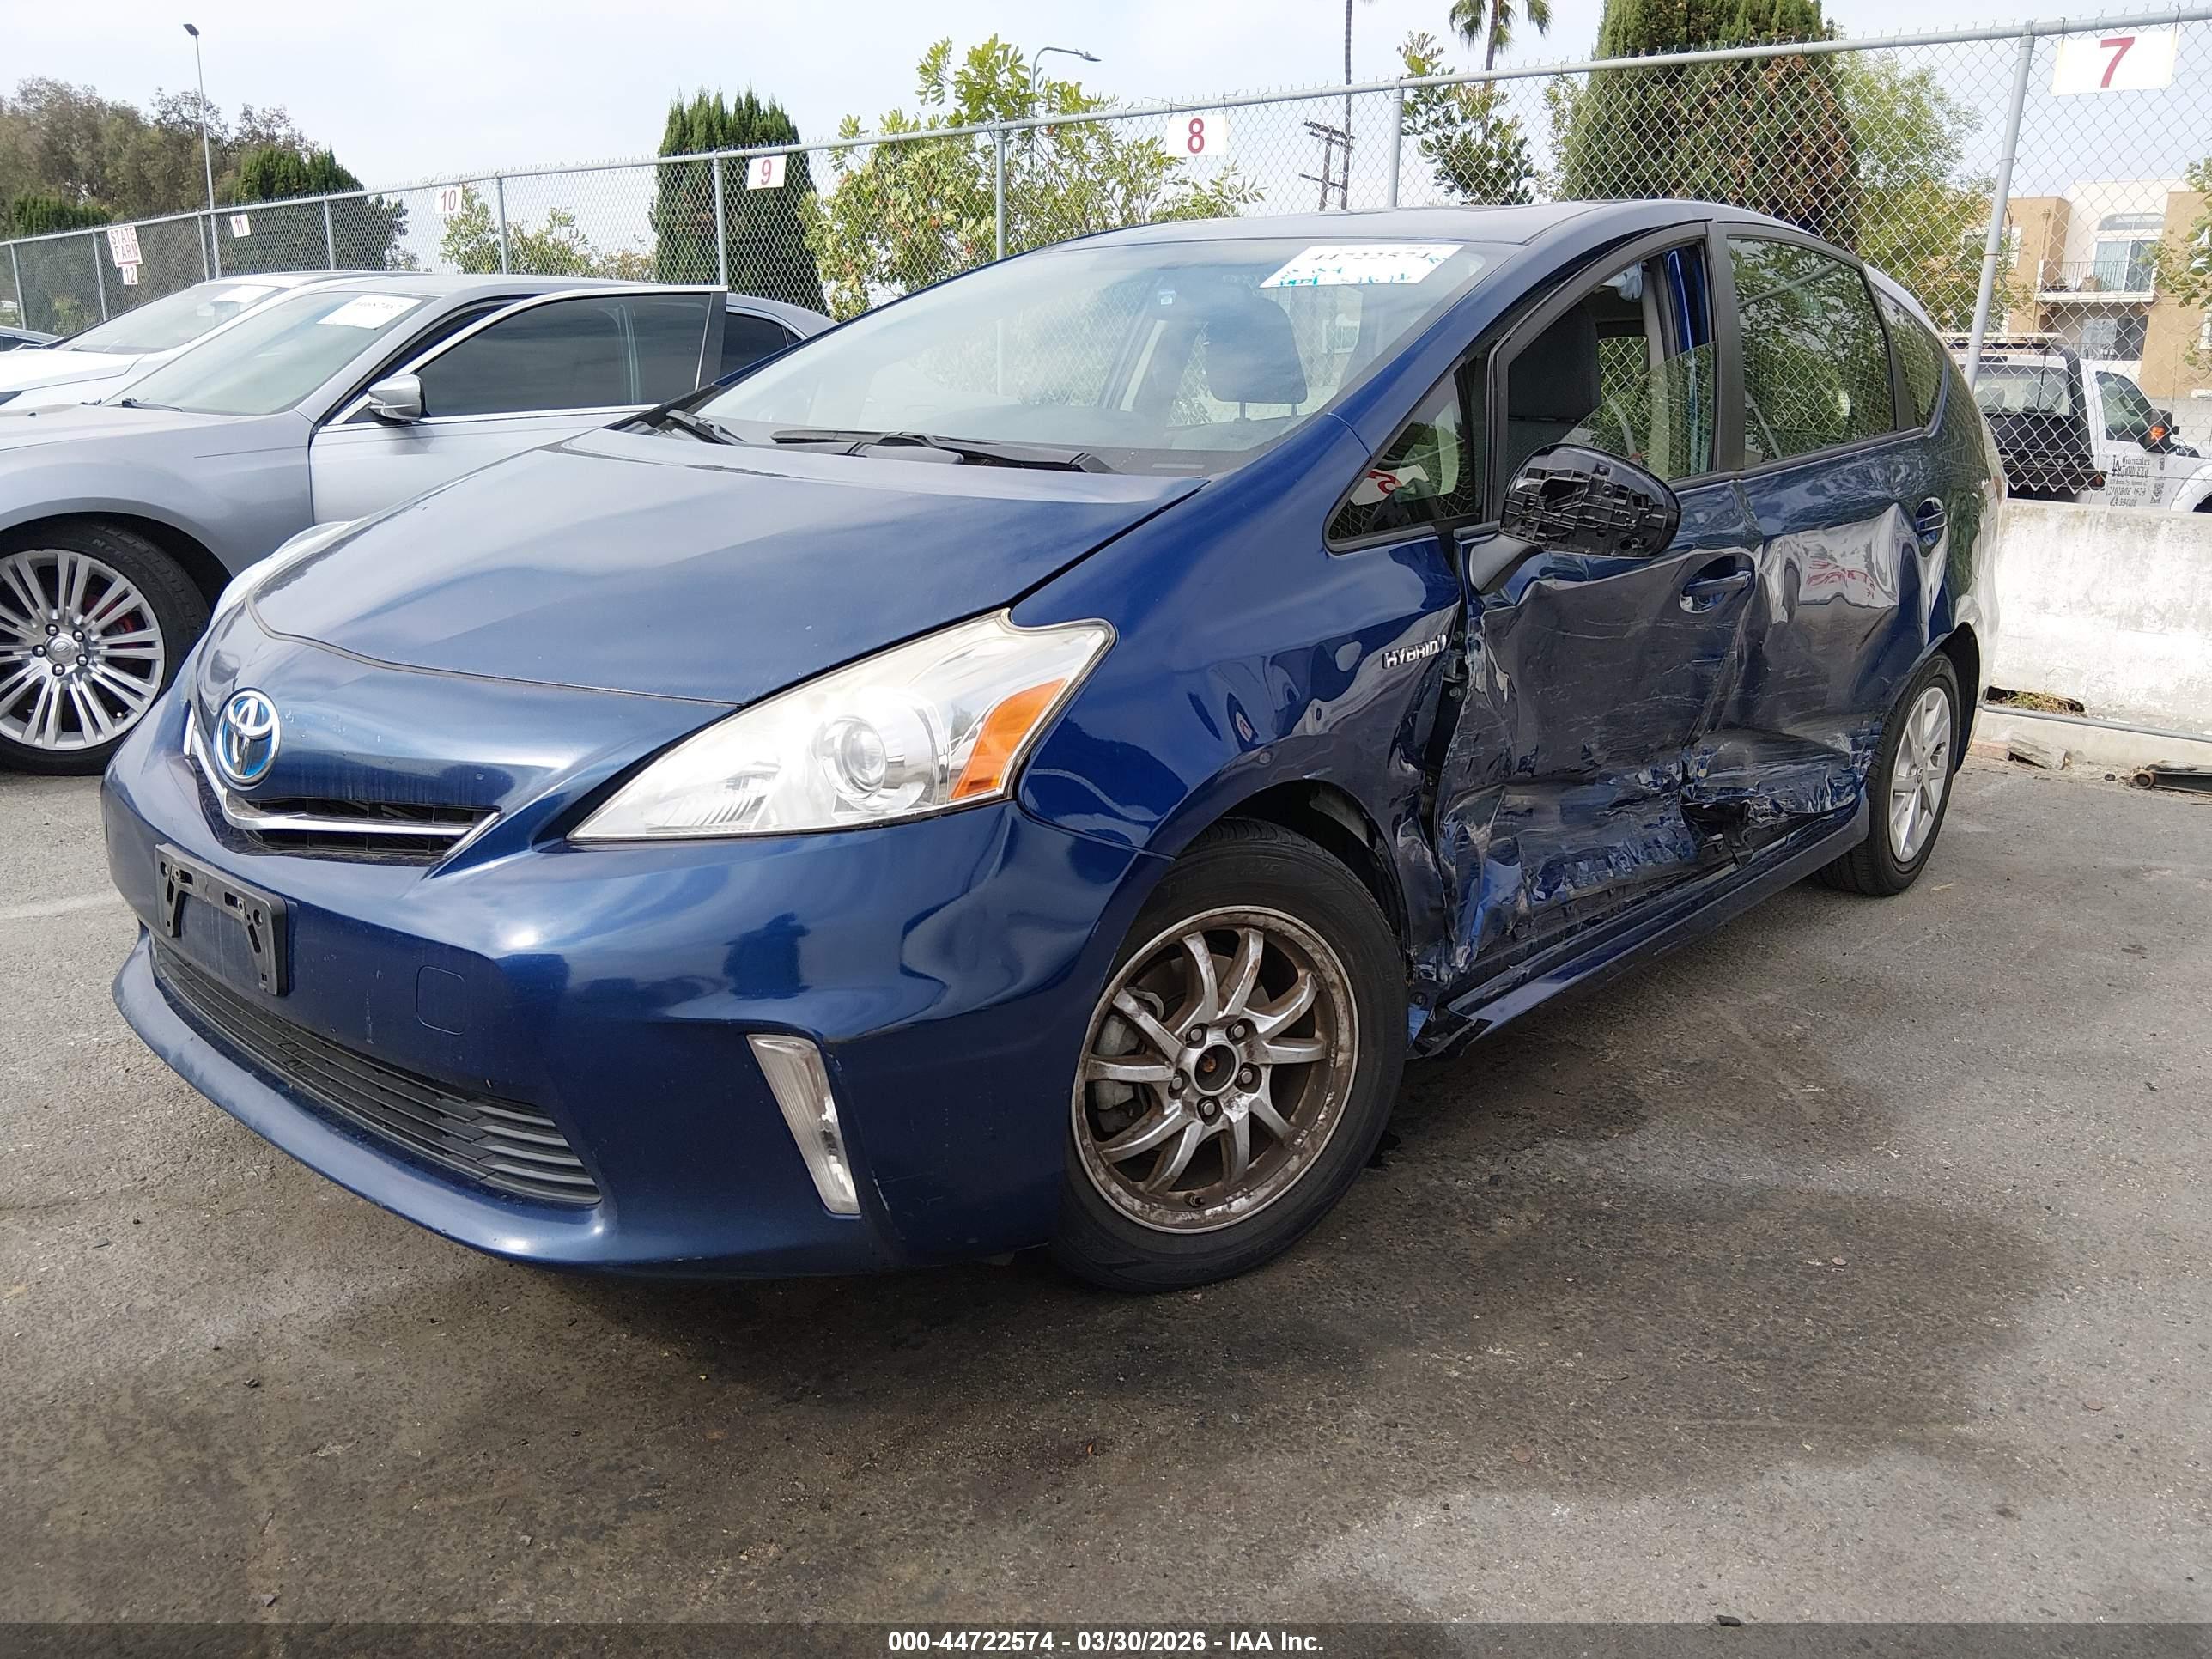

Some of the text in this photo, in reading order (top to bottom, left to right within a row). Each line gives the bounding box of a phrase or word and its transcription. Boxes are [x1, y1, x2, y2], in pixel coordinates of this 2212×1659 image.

[2100, 36, 2136, 88] 7
[1188, 118, 1205, 154] 8
[761, 159, 772, 185] 9
[441, 190, 457, 212] 10
[110, 227, 137, 245] STATE
[234, 216, 245, 235] 11
[114, 243, 139, 260] FARM
[125, 266, 136, 283] 12
[1384, 641, 1441, 668] HYBRID
